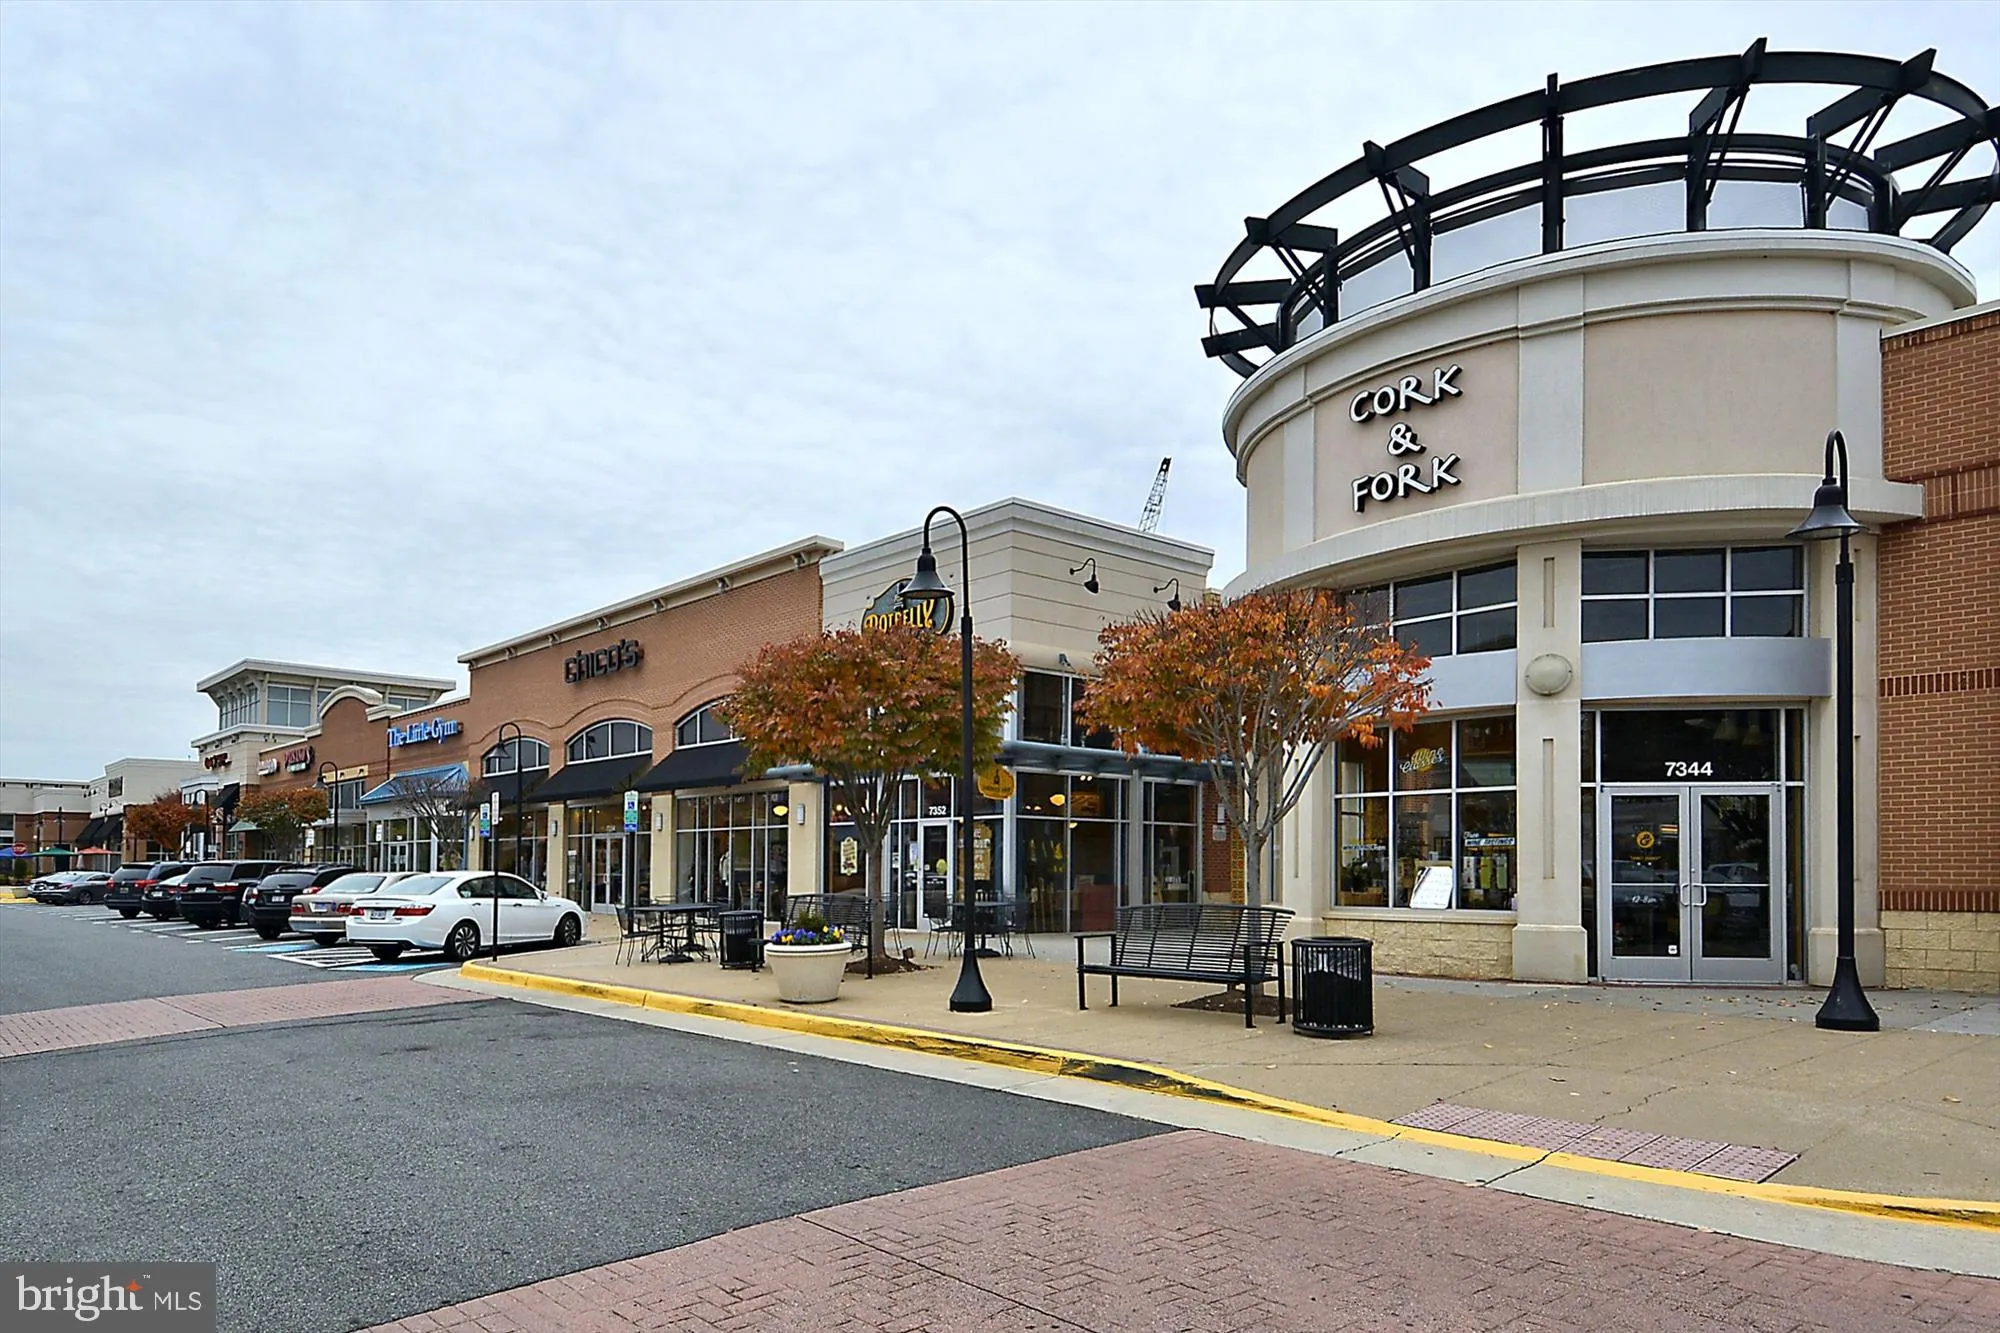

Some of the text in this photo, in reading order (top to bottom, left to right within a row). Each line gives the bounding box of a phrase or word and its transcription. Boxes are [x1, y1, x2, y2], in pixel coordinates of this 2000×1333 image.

[1350, 364, 1463, 423] CORK
[1387, 422, 1427, 456] &
[1352, 453, 1462, 513] FORK
[386, 717, 458, 748] The Little Gym
[1665, 761, 1713, 777] 7344
[928, 805, 947, 815] 7352
